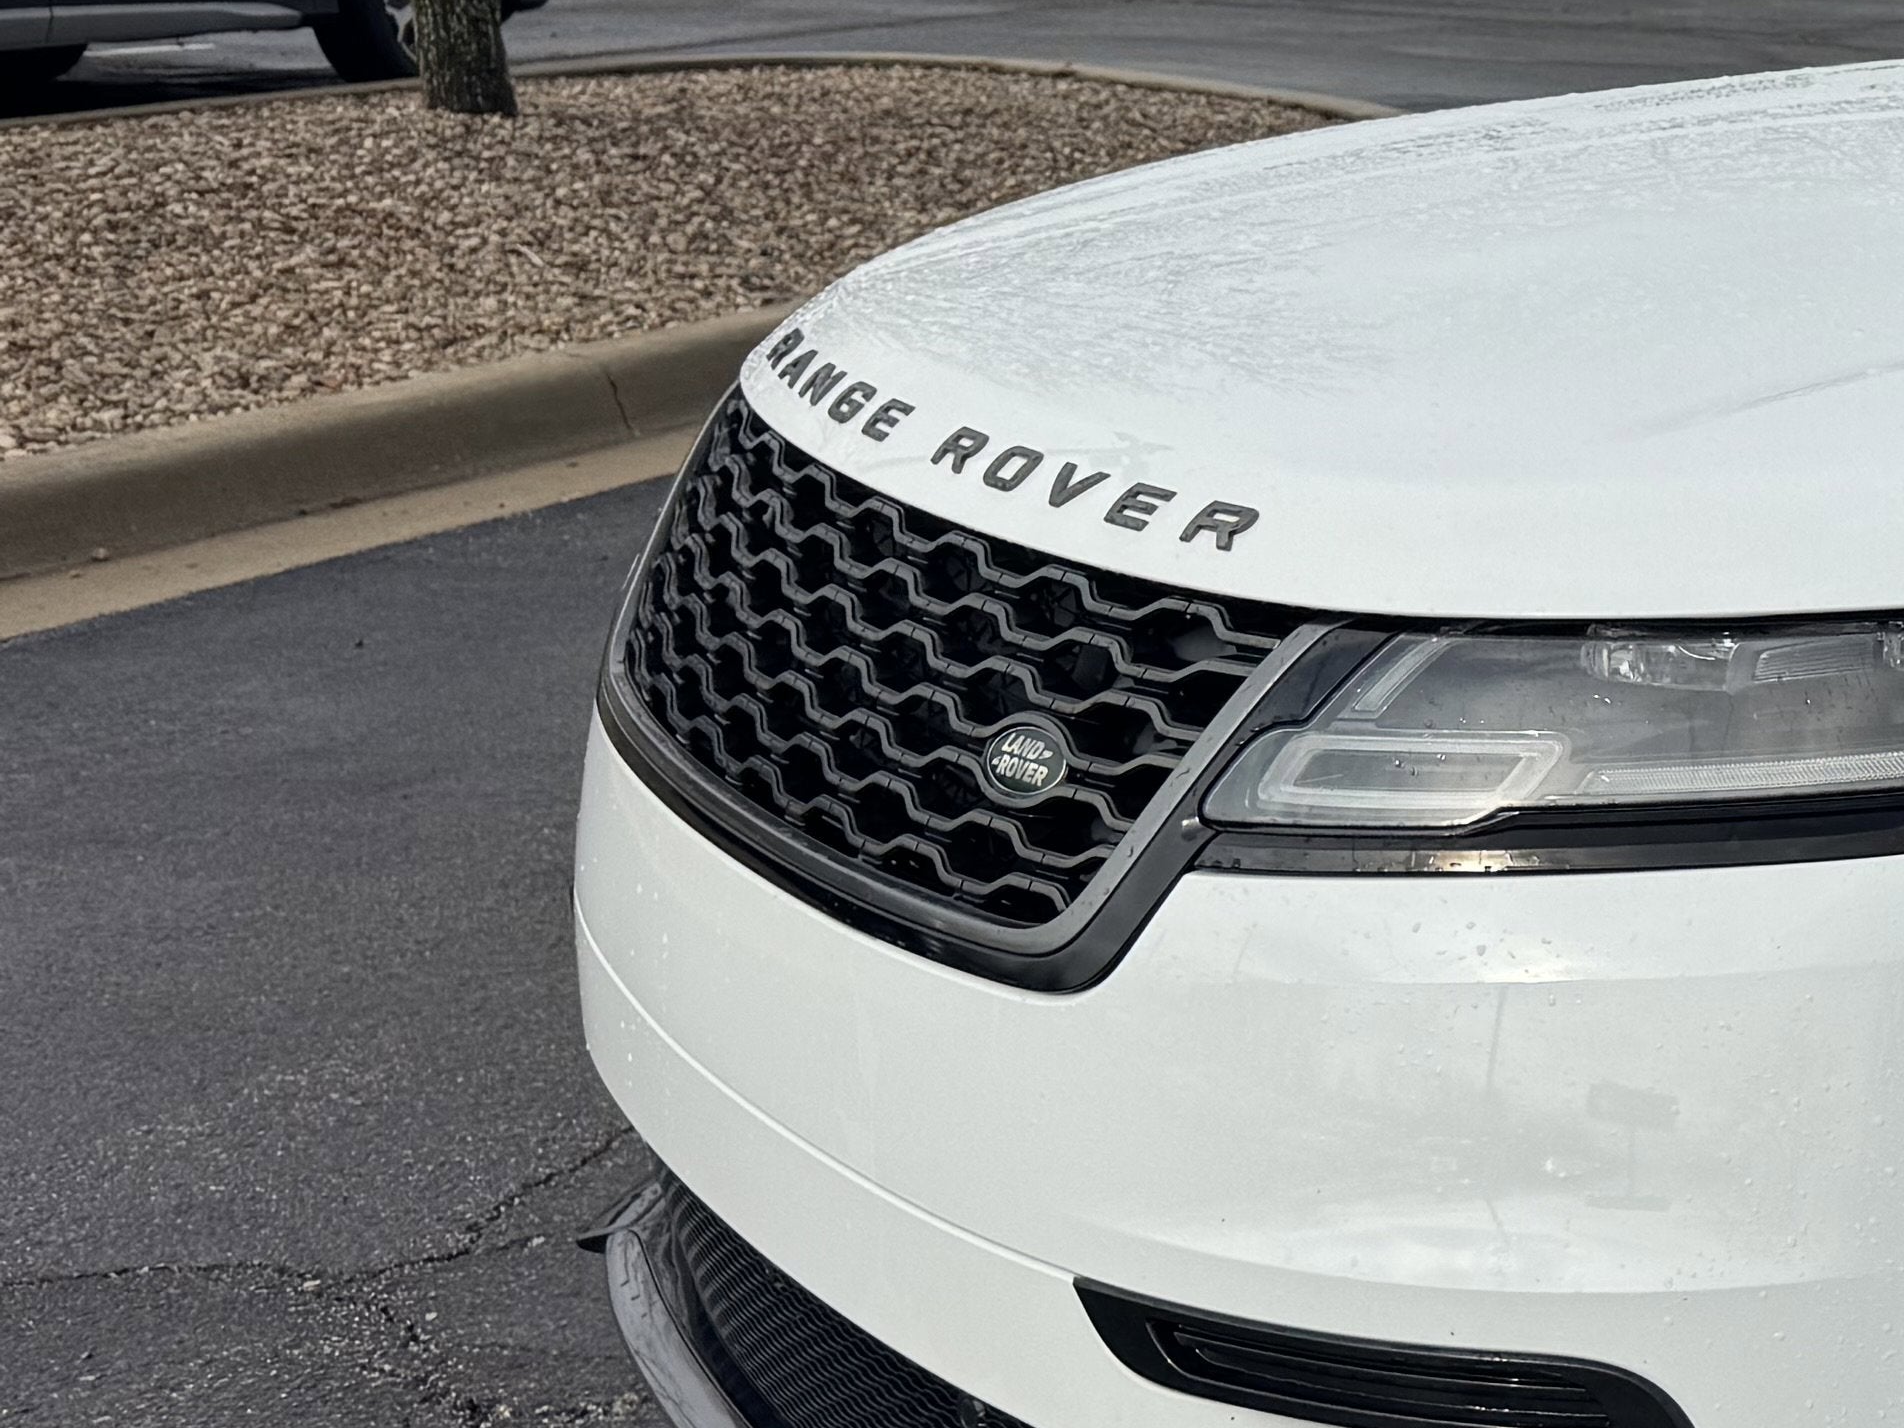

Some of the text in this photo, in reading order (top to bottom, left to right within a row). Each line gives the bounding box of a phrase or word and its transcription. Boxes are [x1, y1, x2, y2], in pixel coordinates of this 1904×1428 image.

[767, 328, 1260, 552] RANGE ROVER
[995, 753, 1049, 787] ROVER
